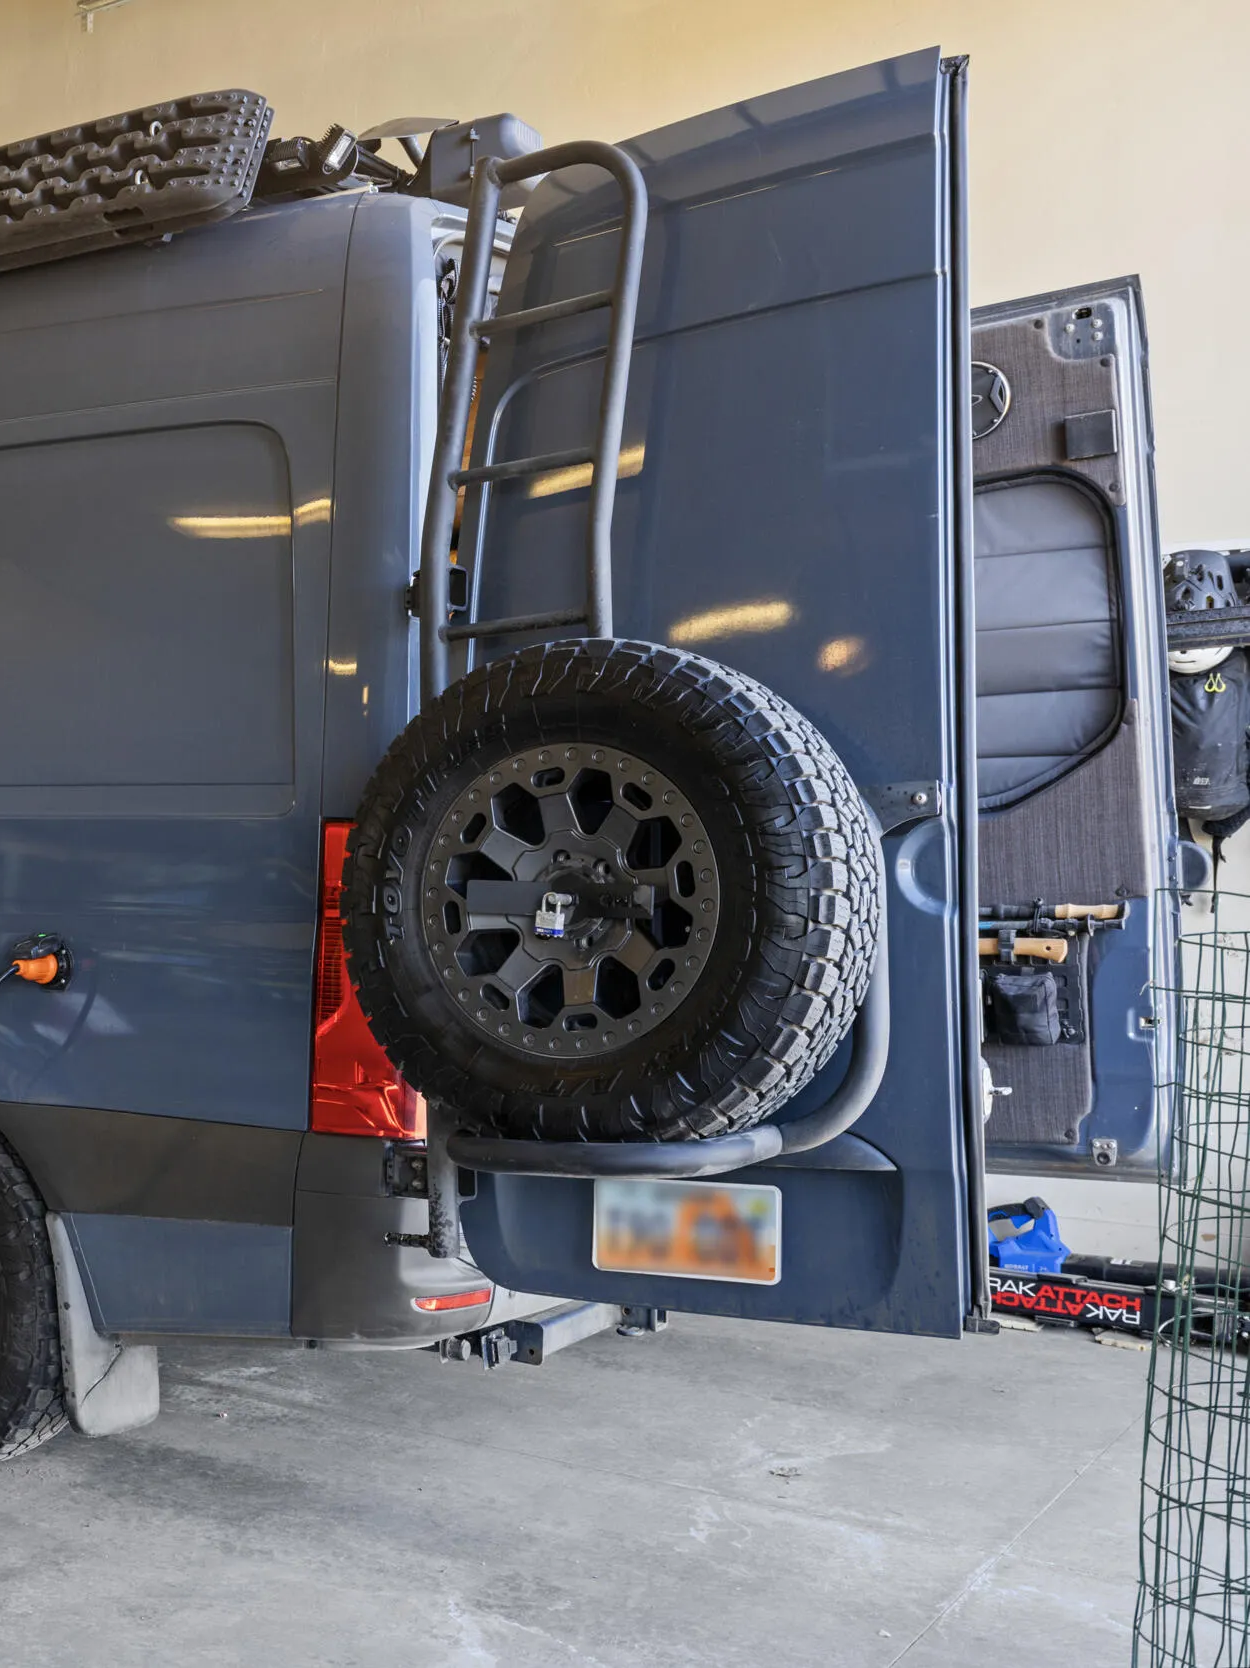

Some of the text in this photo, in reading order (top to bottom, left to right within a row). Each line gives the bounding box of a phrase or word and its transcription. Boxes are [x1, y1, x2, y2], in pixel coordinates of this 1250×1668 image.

[383, 823, 414, 944] TOYO
[989, 1277, 1141, 1312] RAK ATTACH
[1086, 1303, 1141, 1325] RAK
